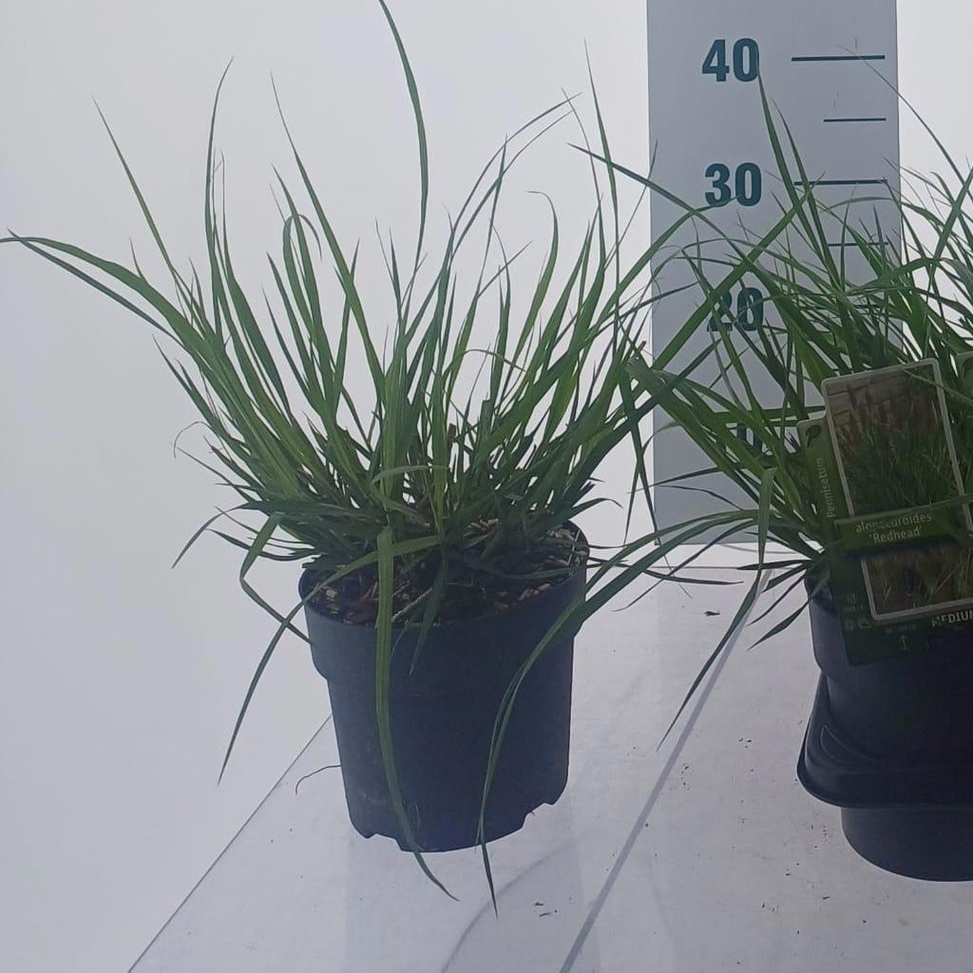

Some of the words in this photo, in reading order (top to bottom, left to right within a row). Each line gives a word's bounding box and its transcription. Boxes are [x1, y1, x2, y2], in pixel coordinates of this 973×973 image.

[701, 37, 759, 83] 40
[704, 162, 762, 207] 30
[816, 457, 836, 518] Pennisetum
